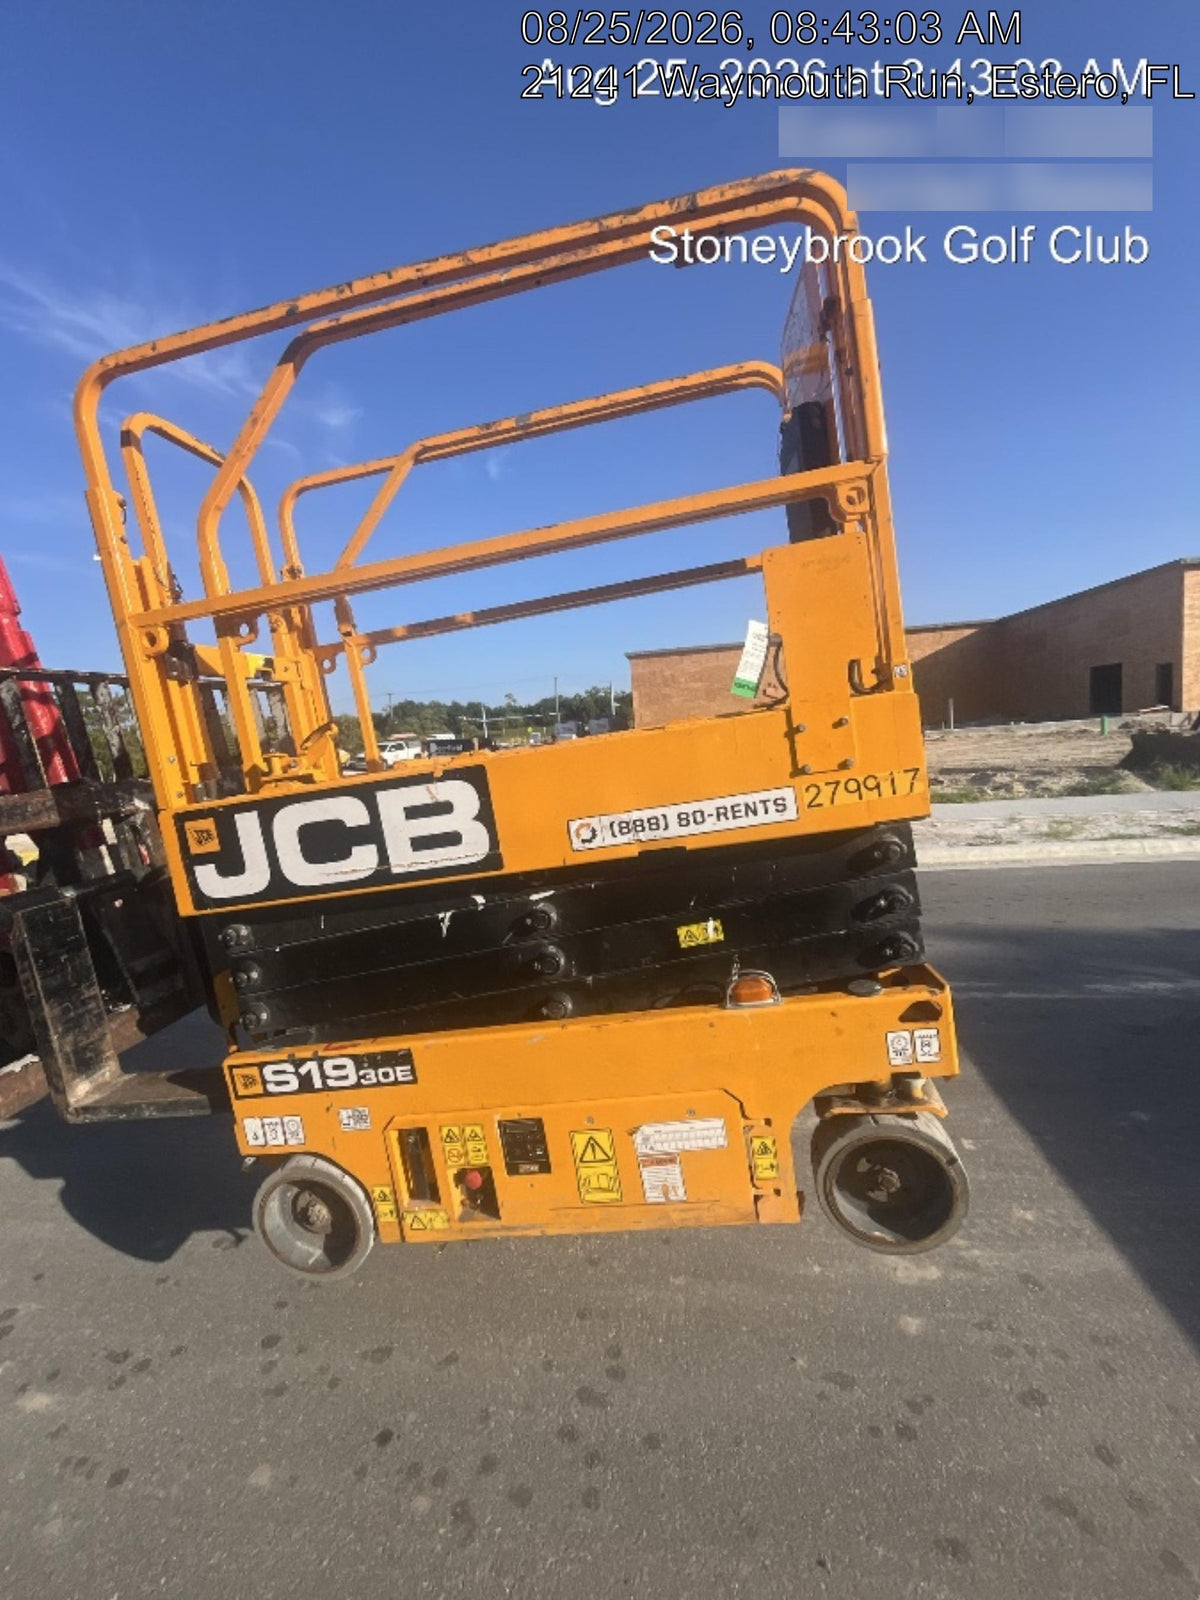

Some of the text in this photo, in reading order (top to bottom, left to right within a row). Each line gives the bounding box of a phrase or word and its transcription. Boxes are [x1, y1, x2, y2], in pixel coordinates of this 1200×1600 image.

[805, 768, 920, 809] 279917
[609, 797, 788, 838] (888) 80-RENTS
[193, 779, 490, 899] JCB
